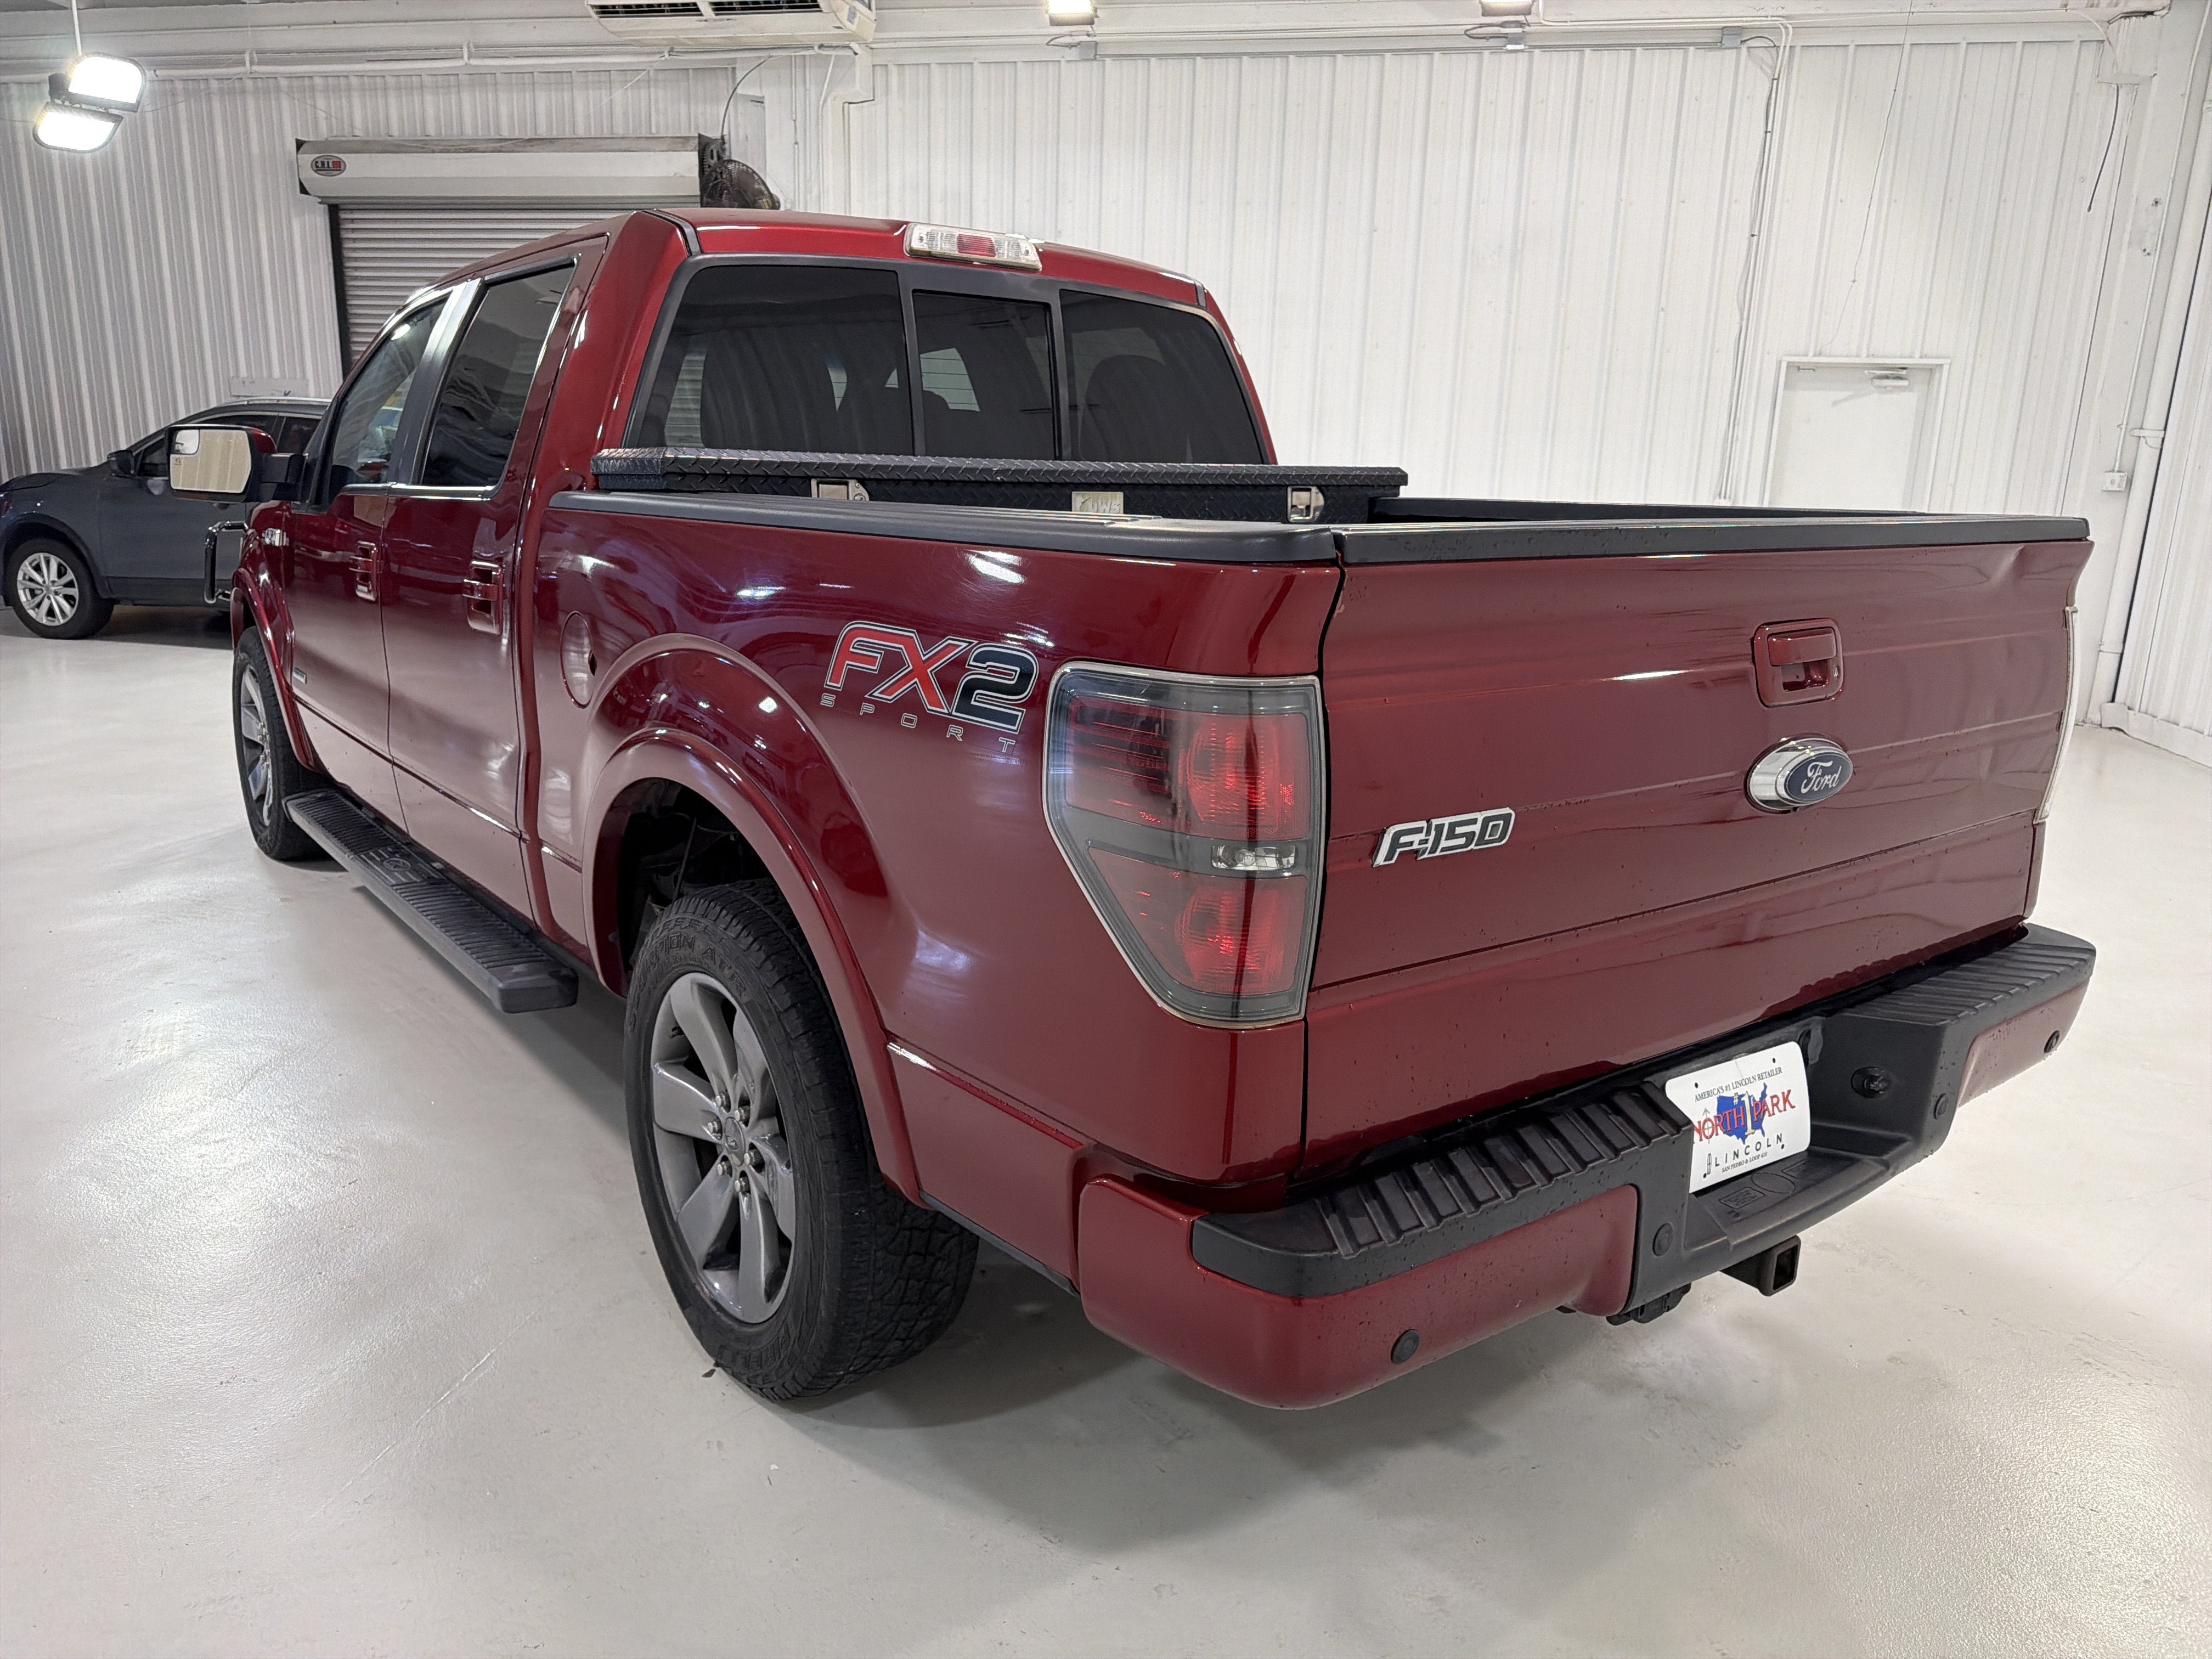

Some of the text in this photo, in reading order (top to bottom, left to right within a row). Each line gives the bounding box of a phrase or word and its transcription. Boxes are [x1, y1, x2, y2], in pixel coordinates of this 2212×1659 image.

[824, 620, 1039, 734] FX2
[820, 692, 1016, 753] SPORT
[1801, 760, 1842, 794] Ford
[1372, 807, 1515, 868] F-150
[1695, 1085, 1724, 1102] AMERICA'S
[1732, 1074, 1757, 1090] LINCOLN
[1757, 1066, 1783, 1081] RETAILER
[1694, 1089, 1796, 1142] NORTH PARK
[1715, 1133, 1782, 1167] LINCOLN
[1730, 1160, 1745, 1170] PEDRO
[1749, 1154, 1760, 1163] LOOP
